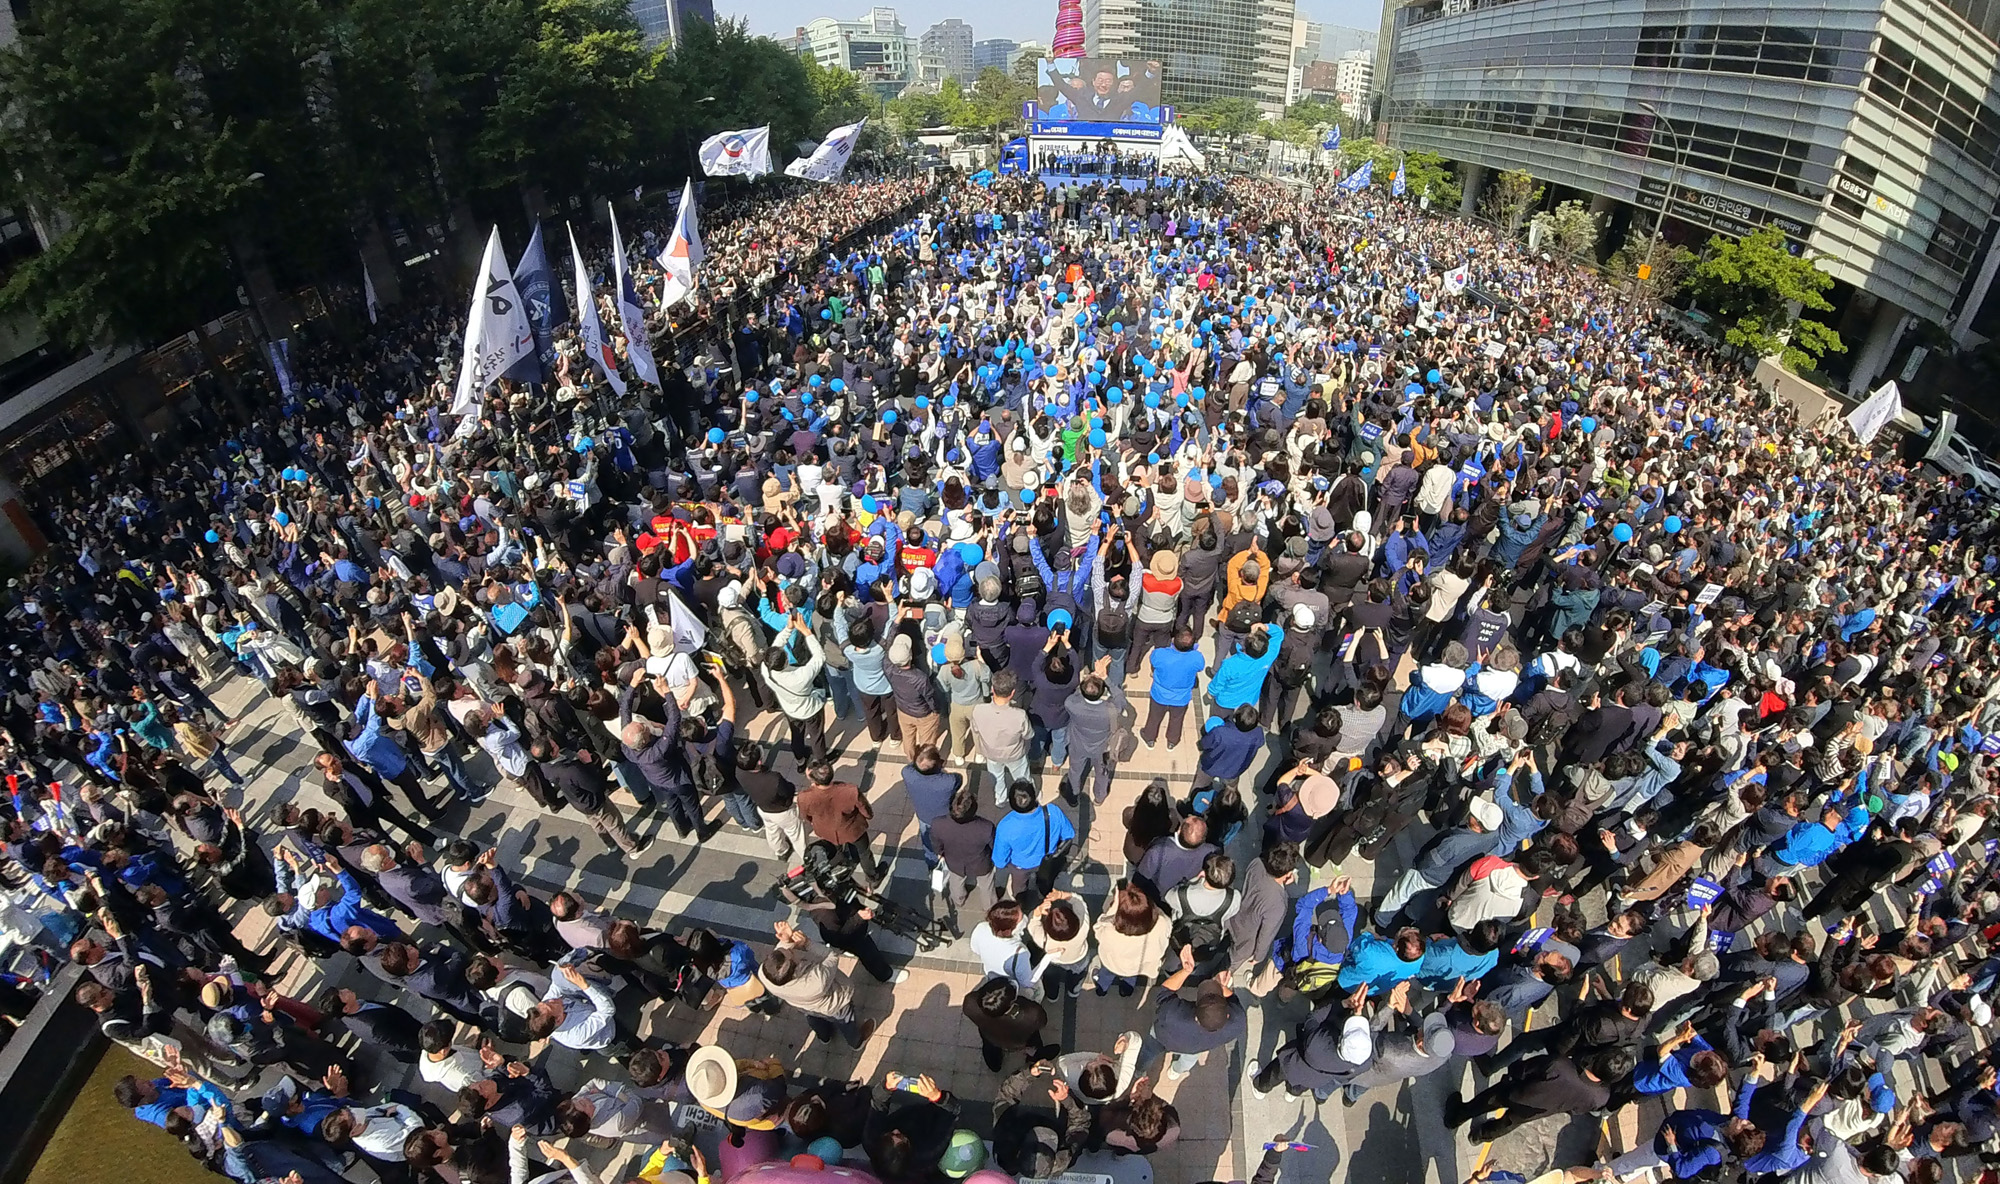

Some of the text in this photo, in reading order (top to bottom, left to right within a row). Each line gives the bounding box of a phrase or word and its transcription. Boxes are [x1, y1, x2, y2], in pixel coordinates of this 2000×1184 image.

[1026, 102, 1034, 118] 1
[1163, 107, 1170, 123] 1
[1699, 194, 1752, 220] KB 국민은행
[685, 1106, 719, 1126] HECHI
